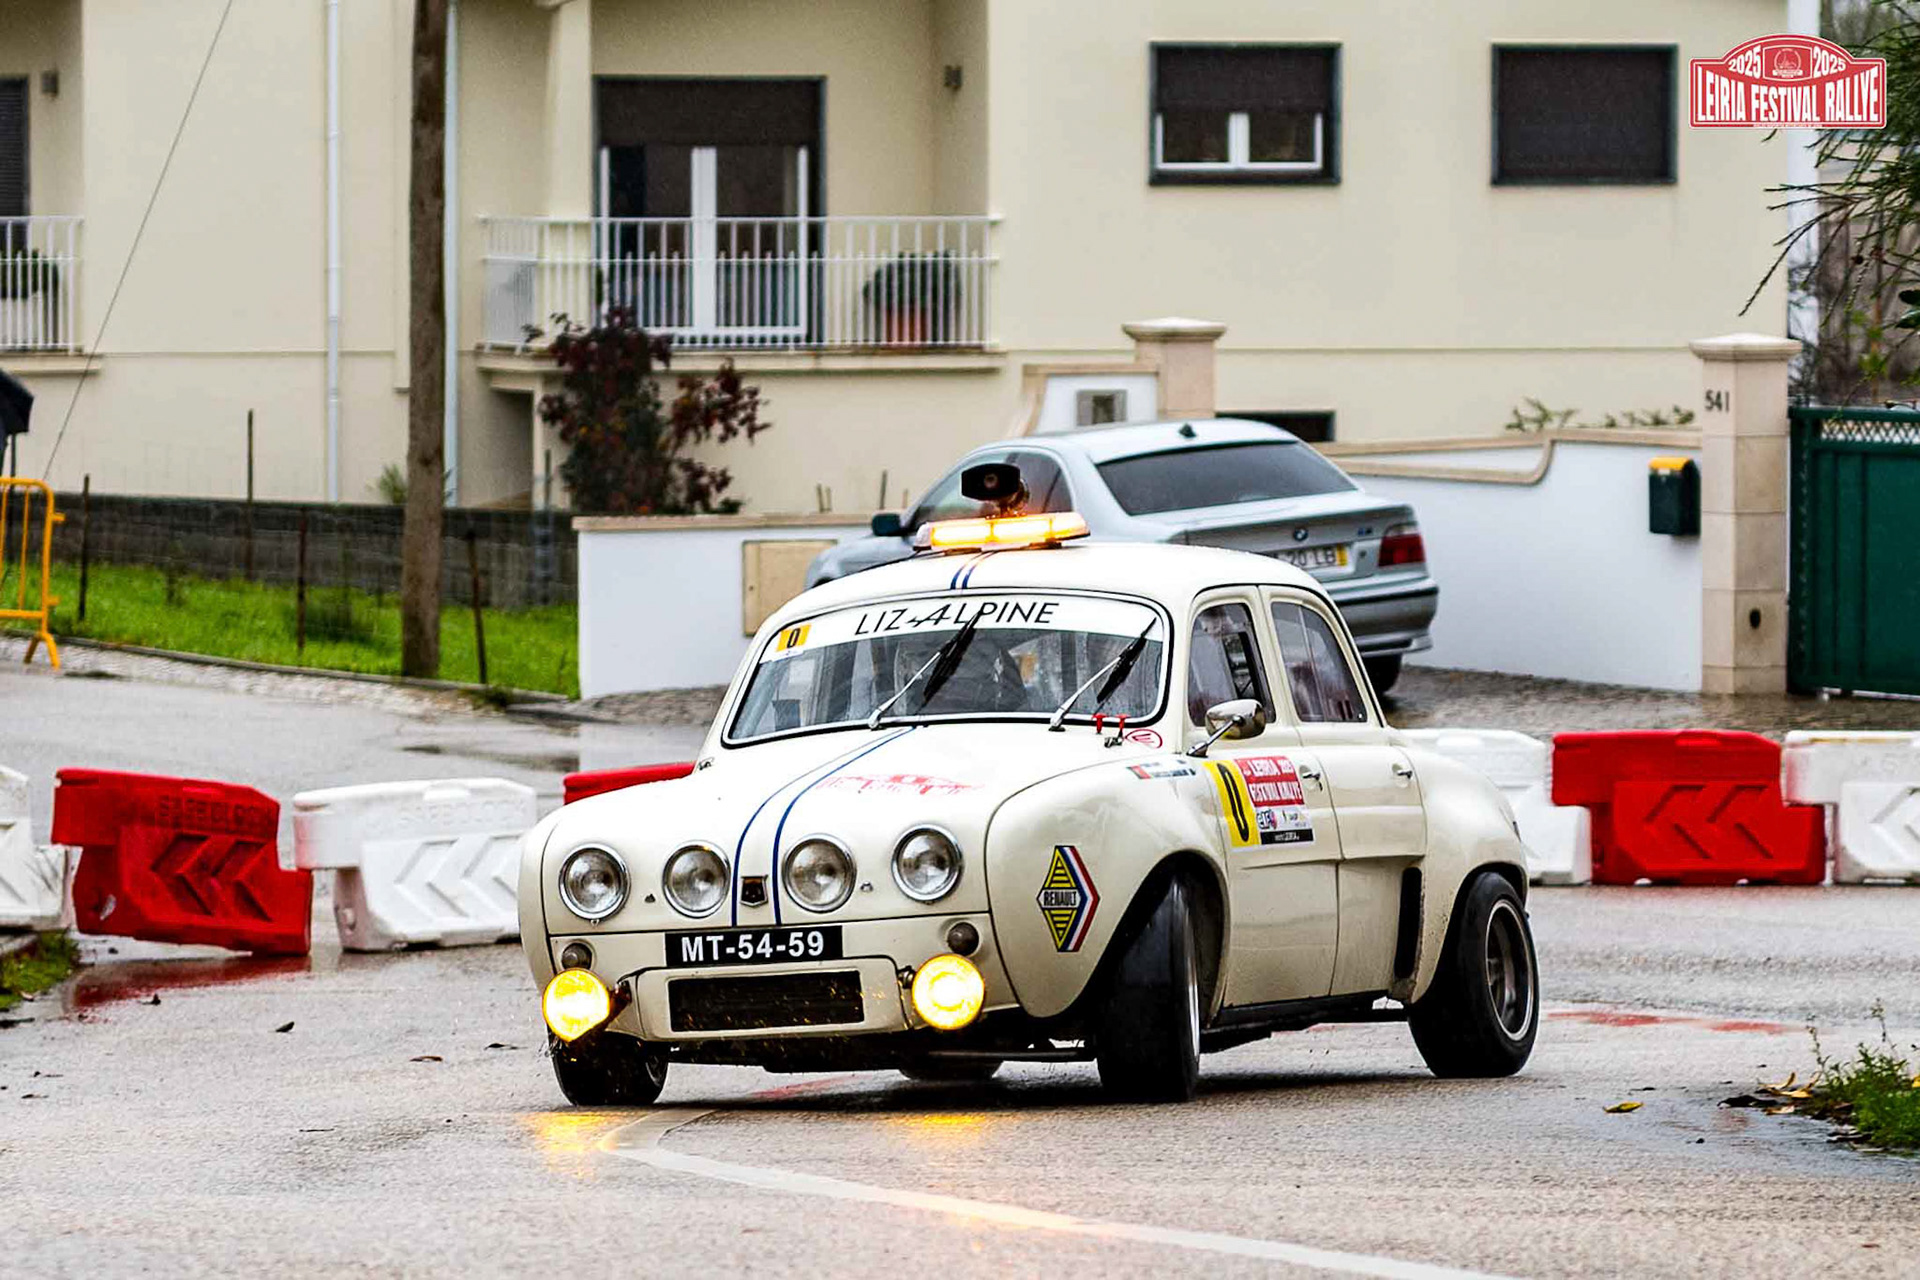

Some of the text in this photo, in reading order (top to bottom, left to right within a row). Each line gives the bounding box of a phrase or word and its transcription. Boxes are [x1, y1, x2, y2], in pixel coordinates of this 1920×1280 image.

[1704, 389, 1730, 413] 541
[786, 627, 802, 649] 0
[1216, 762, 1250, 842] 0
[1043, 890, 1078, 907] RENAULT
[681, 930, 824, 963] MT-54-59
